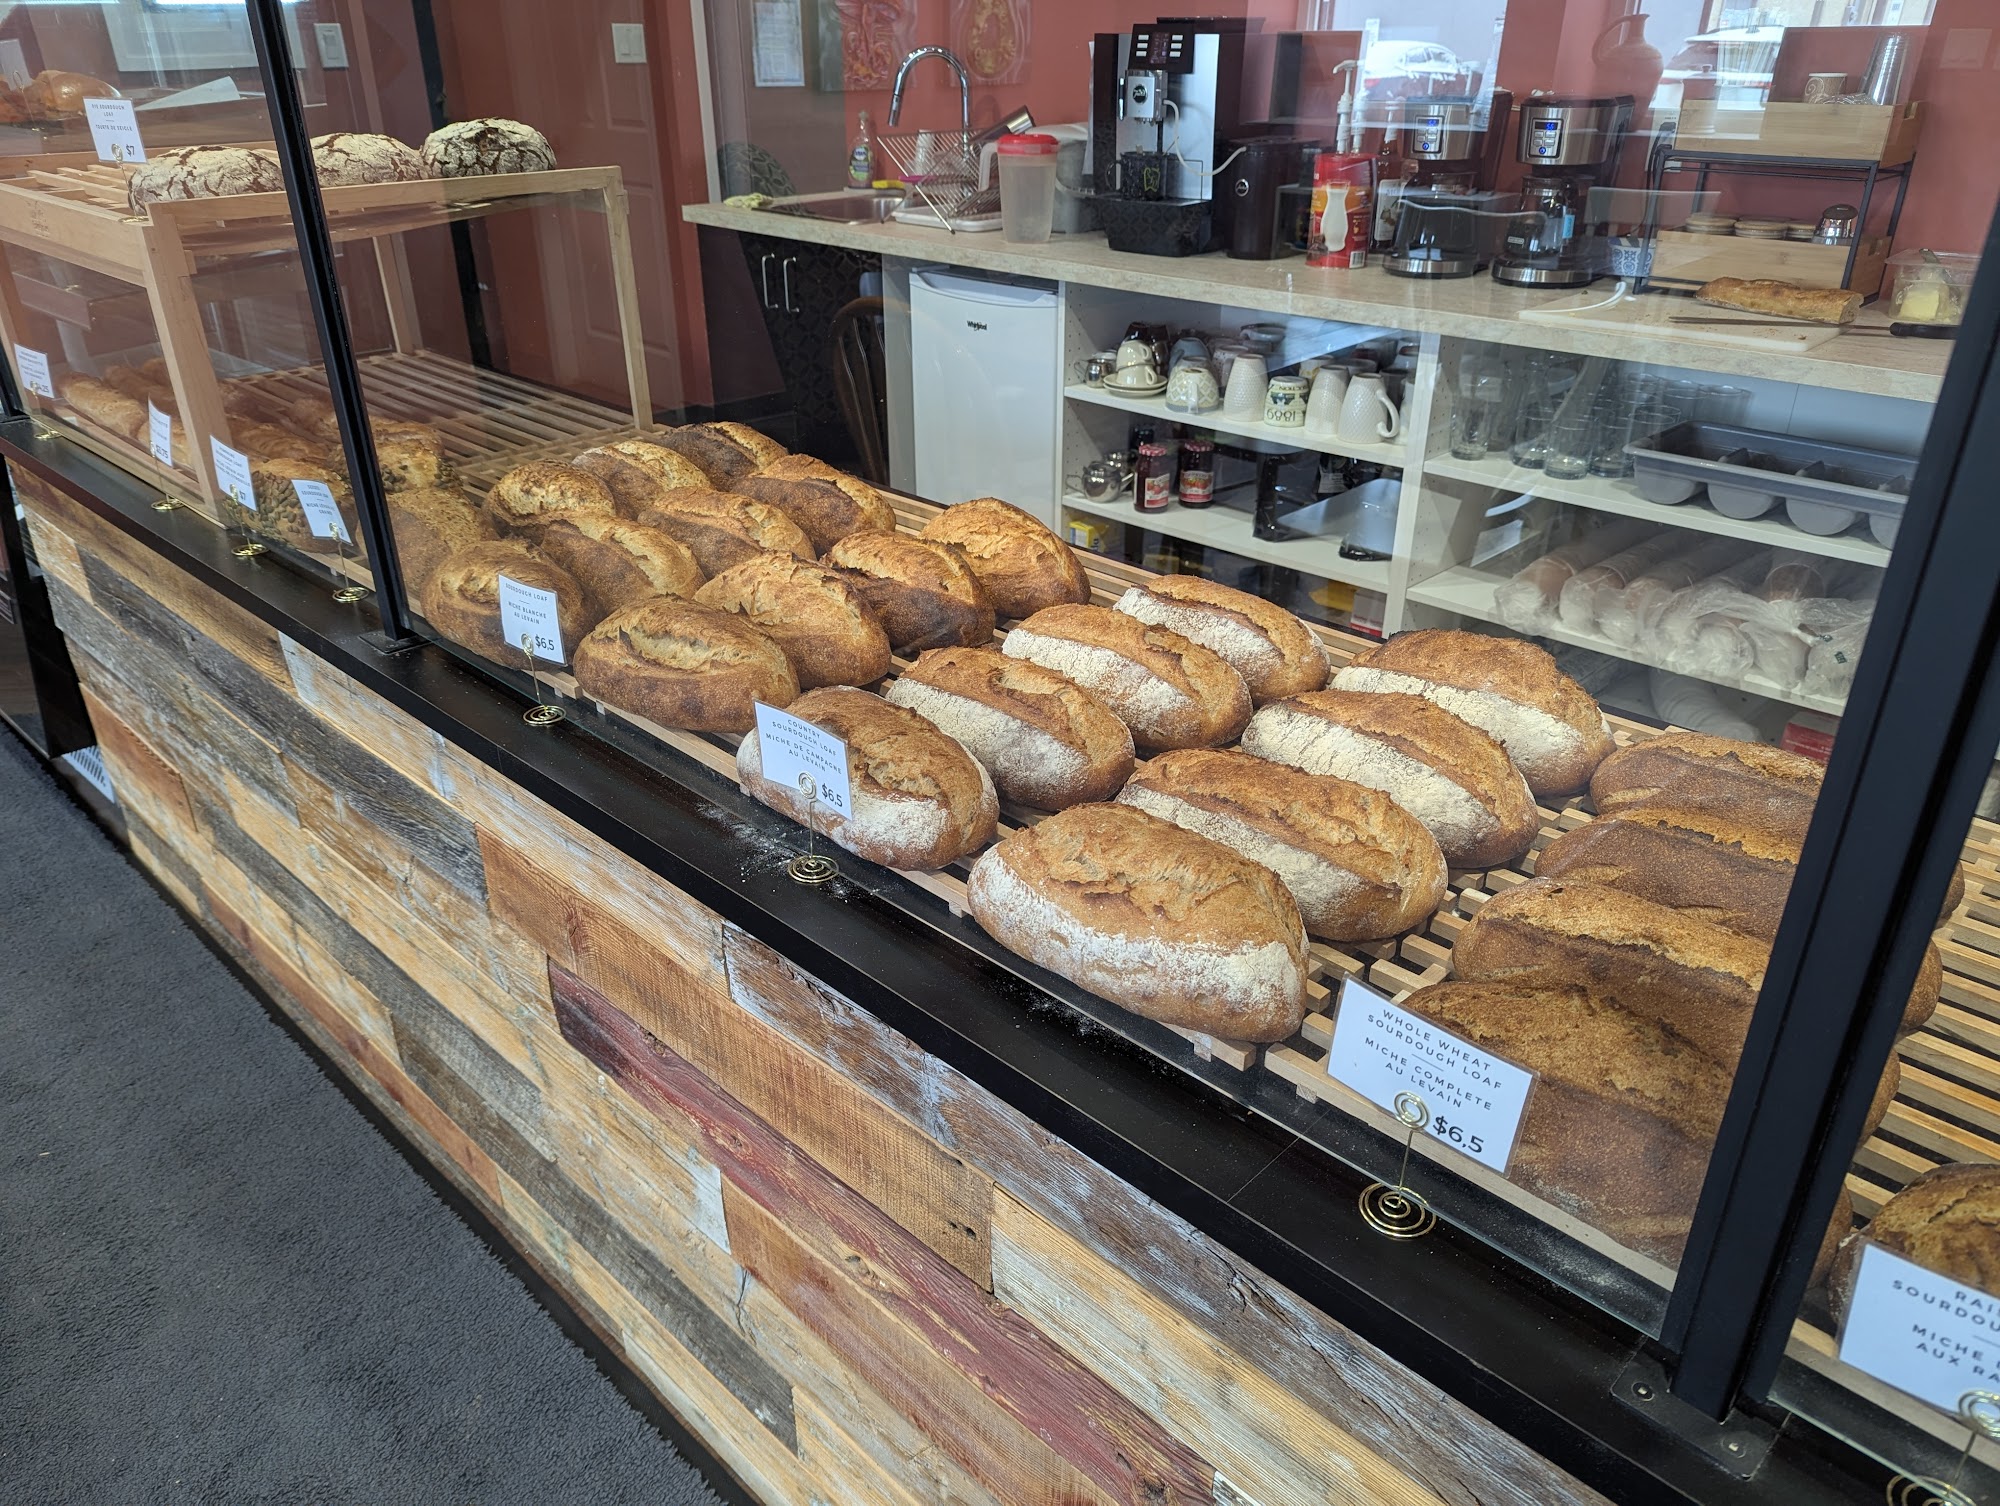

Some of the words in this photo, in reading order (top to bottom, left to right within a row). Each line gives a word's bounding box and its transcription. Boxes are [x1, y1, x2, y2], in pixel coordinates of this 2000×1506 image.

[125, 144, 135, 157] $7
[1267, 409, 1296, 422] 1889
[239, 490, 246, 501] $7
[505, 582, 532, 598] SOURDOUGH
[533, 593, 548, 602] LOAF
[508, 601, 521, 611] MICHE
[522, 606, 547, 619] BLANCHE
[521, 614, 540, 625] LEVAIN
[772, 721, 818, 746] SOURDOUGH
[819, 742, 837, 757] LOAF
[787, 719, 821, 739] COUNTRY
[765, 732, 791, 747] MICHE
[793, 742, 804, 752] DE
[806, 748, 842, 775] CAMPAGNE
[788, 749, 799, 757] AU
[801, 753, 826, 772] LEVAIN
[1382, 1009, 1431, 1042] WHOLE
[1438, 1039, 1491, 1071] WHEAT
[1367, 1014, 1455, 1067] SOURDOUGH
[1462, 1065, 1502, 1090] LOAF
[1364, 1037, 1408, 1066] MICHE
[1414, 1066, 1492, 1111] COMPLETE
[1385, 1062, 1403, 1076] AU
[1410, 1075, 1462, 1108] LEVAIN
[1955, 1290, 2000, 1318] RAI
[1912, 1324, 1984, 1361] MICHE
[1916, 1343, 1960, 1366] AUX
